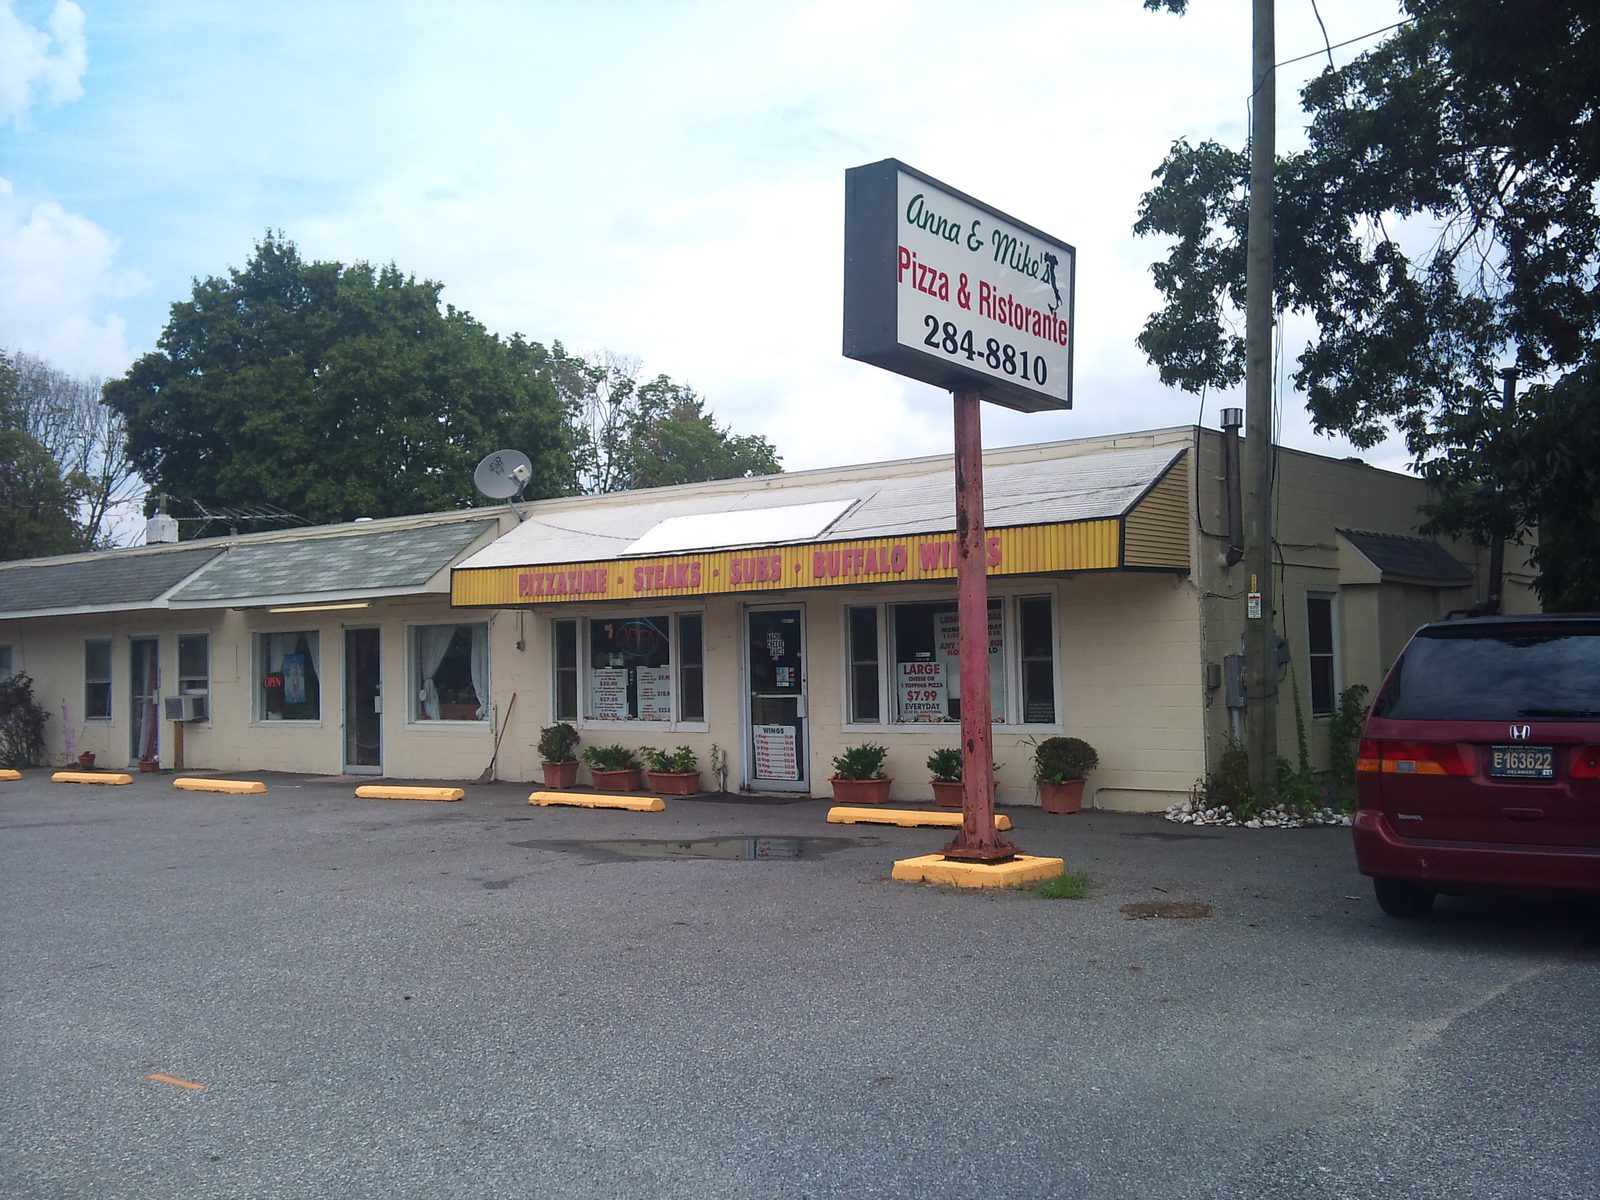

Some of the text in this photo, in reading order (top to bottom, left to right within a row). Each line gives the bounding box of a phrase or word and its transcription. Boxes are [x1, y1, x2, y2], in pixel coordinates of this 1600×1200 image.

[906, 194, 1050, 285] Anna & Mike's
[898, 245, 1068, 346] Pizza & Ristorante
[923, 315, 1047, 385] 284-8810
[518, 536, 1001, 598] PIZZATIME STEAKS SUBS BUFFALO WIS
[264, 676, 281, 688] OPEN
[904, 663, 940, 675] LARGE
[907, 690, 938, 702] $7.99
[1504, 752, 1551, 769] 163622
